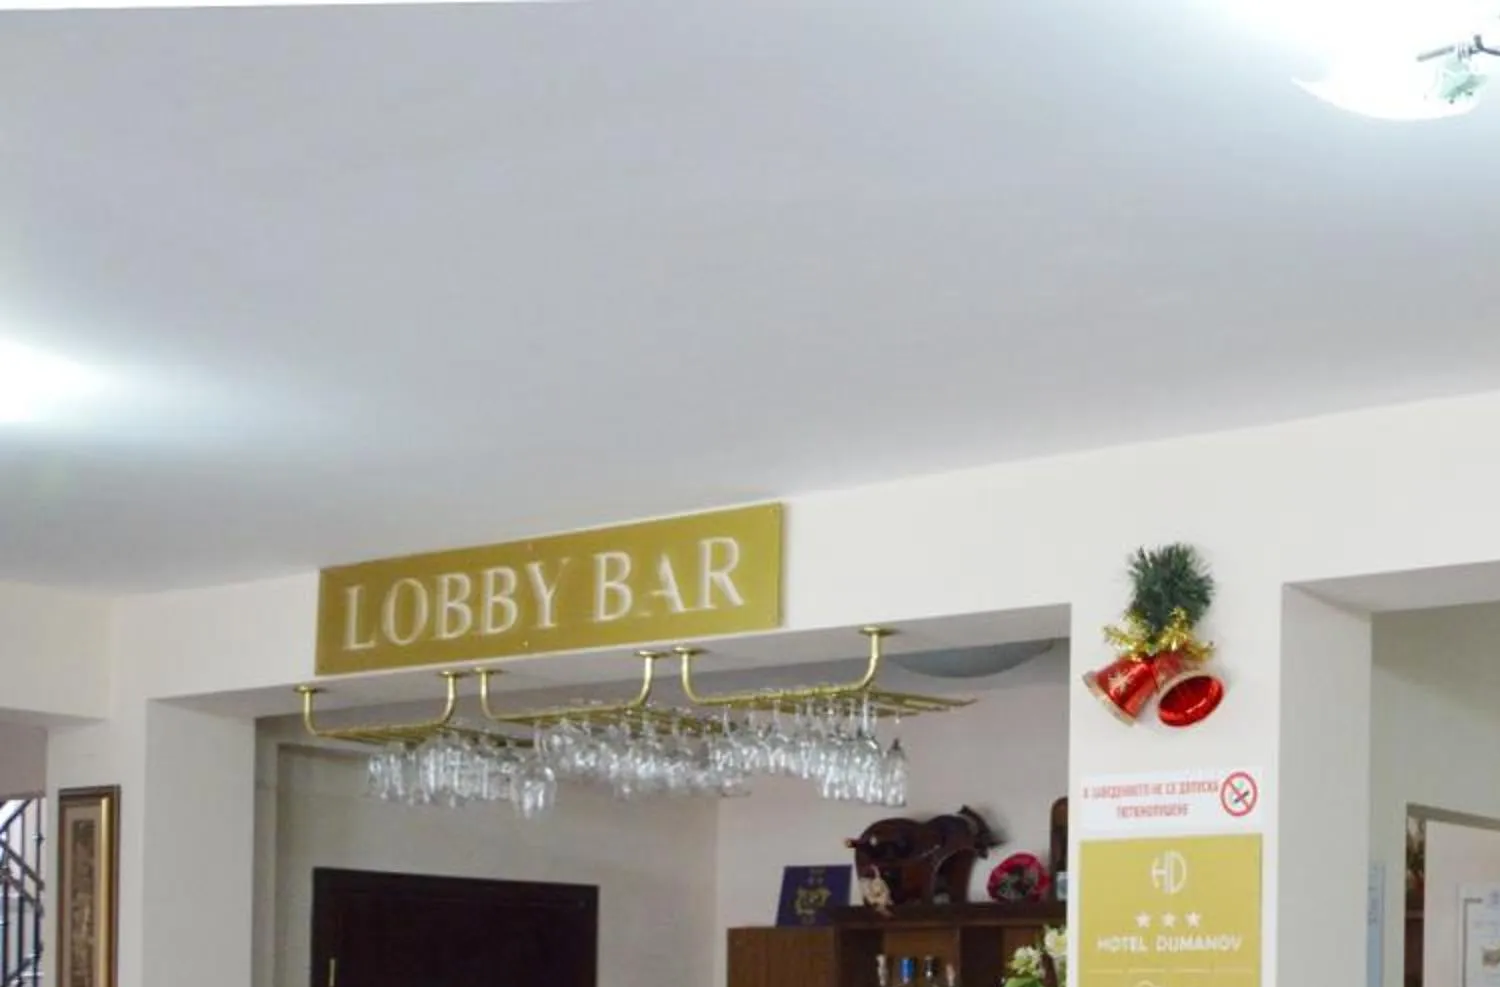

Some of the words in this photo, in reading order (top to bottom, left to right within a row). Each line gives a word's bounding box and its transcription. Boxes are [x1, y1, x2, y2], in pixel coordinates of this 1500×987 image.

[340, 556, 569, 652] LOBBY
[590, 535, 746, 624] BAR
[1097, 935, 1149, 952] HOTEL
[1155, 934, 1243, 951] DUMANOV
